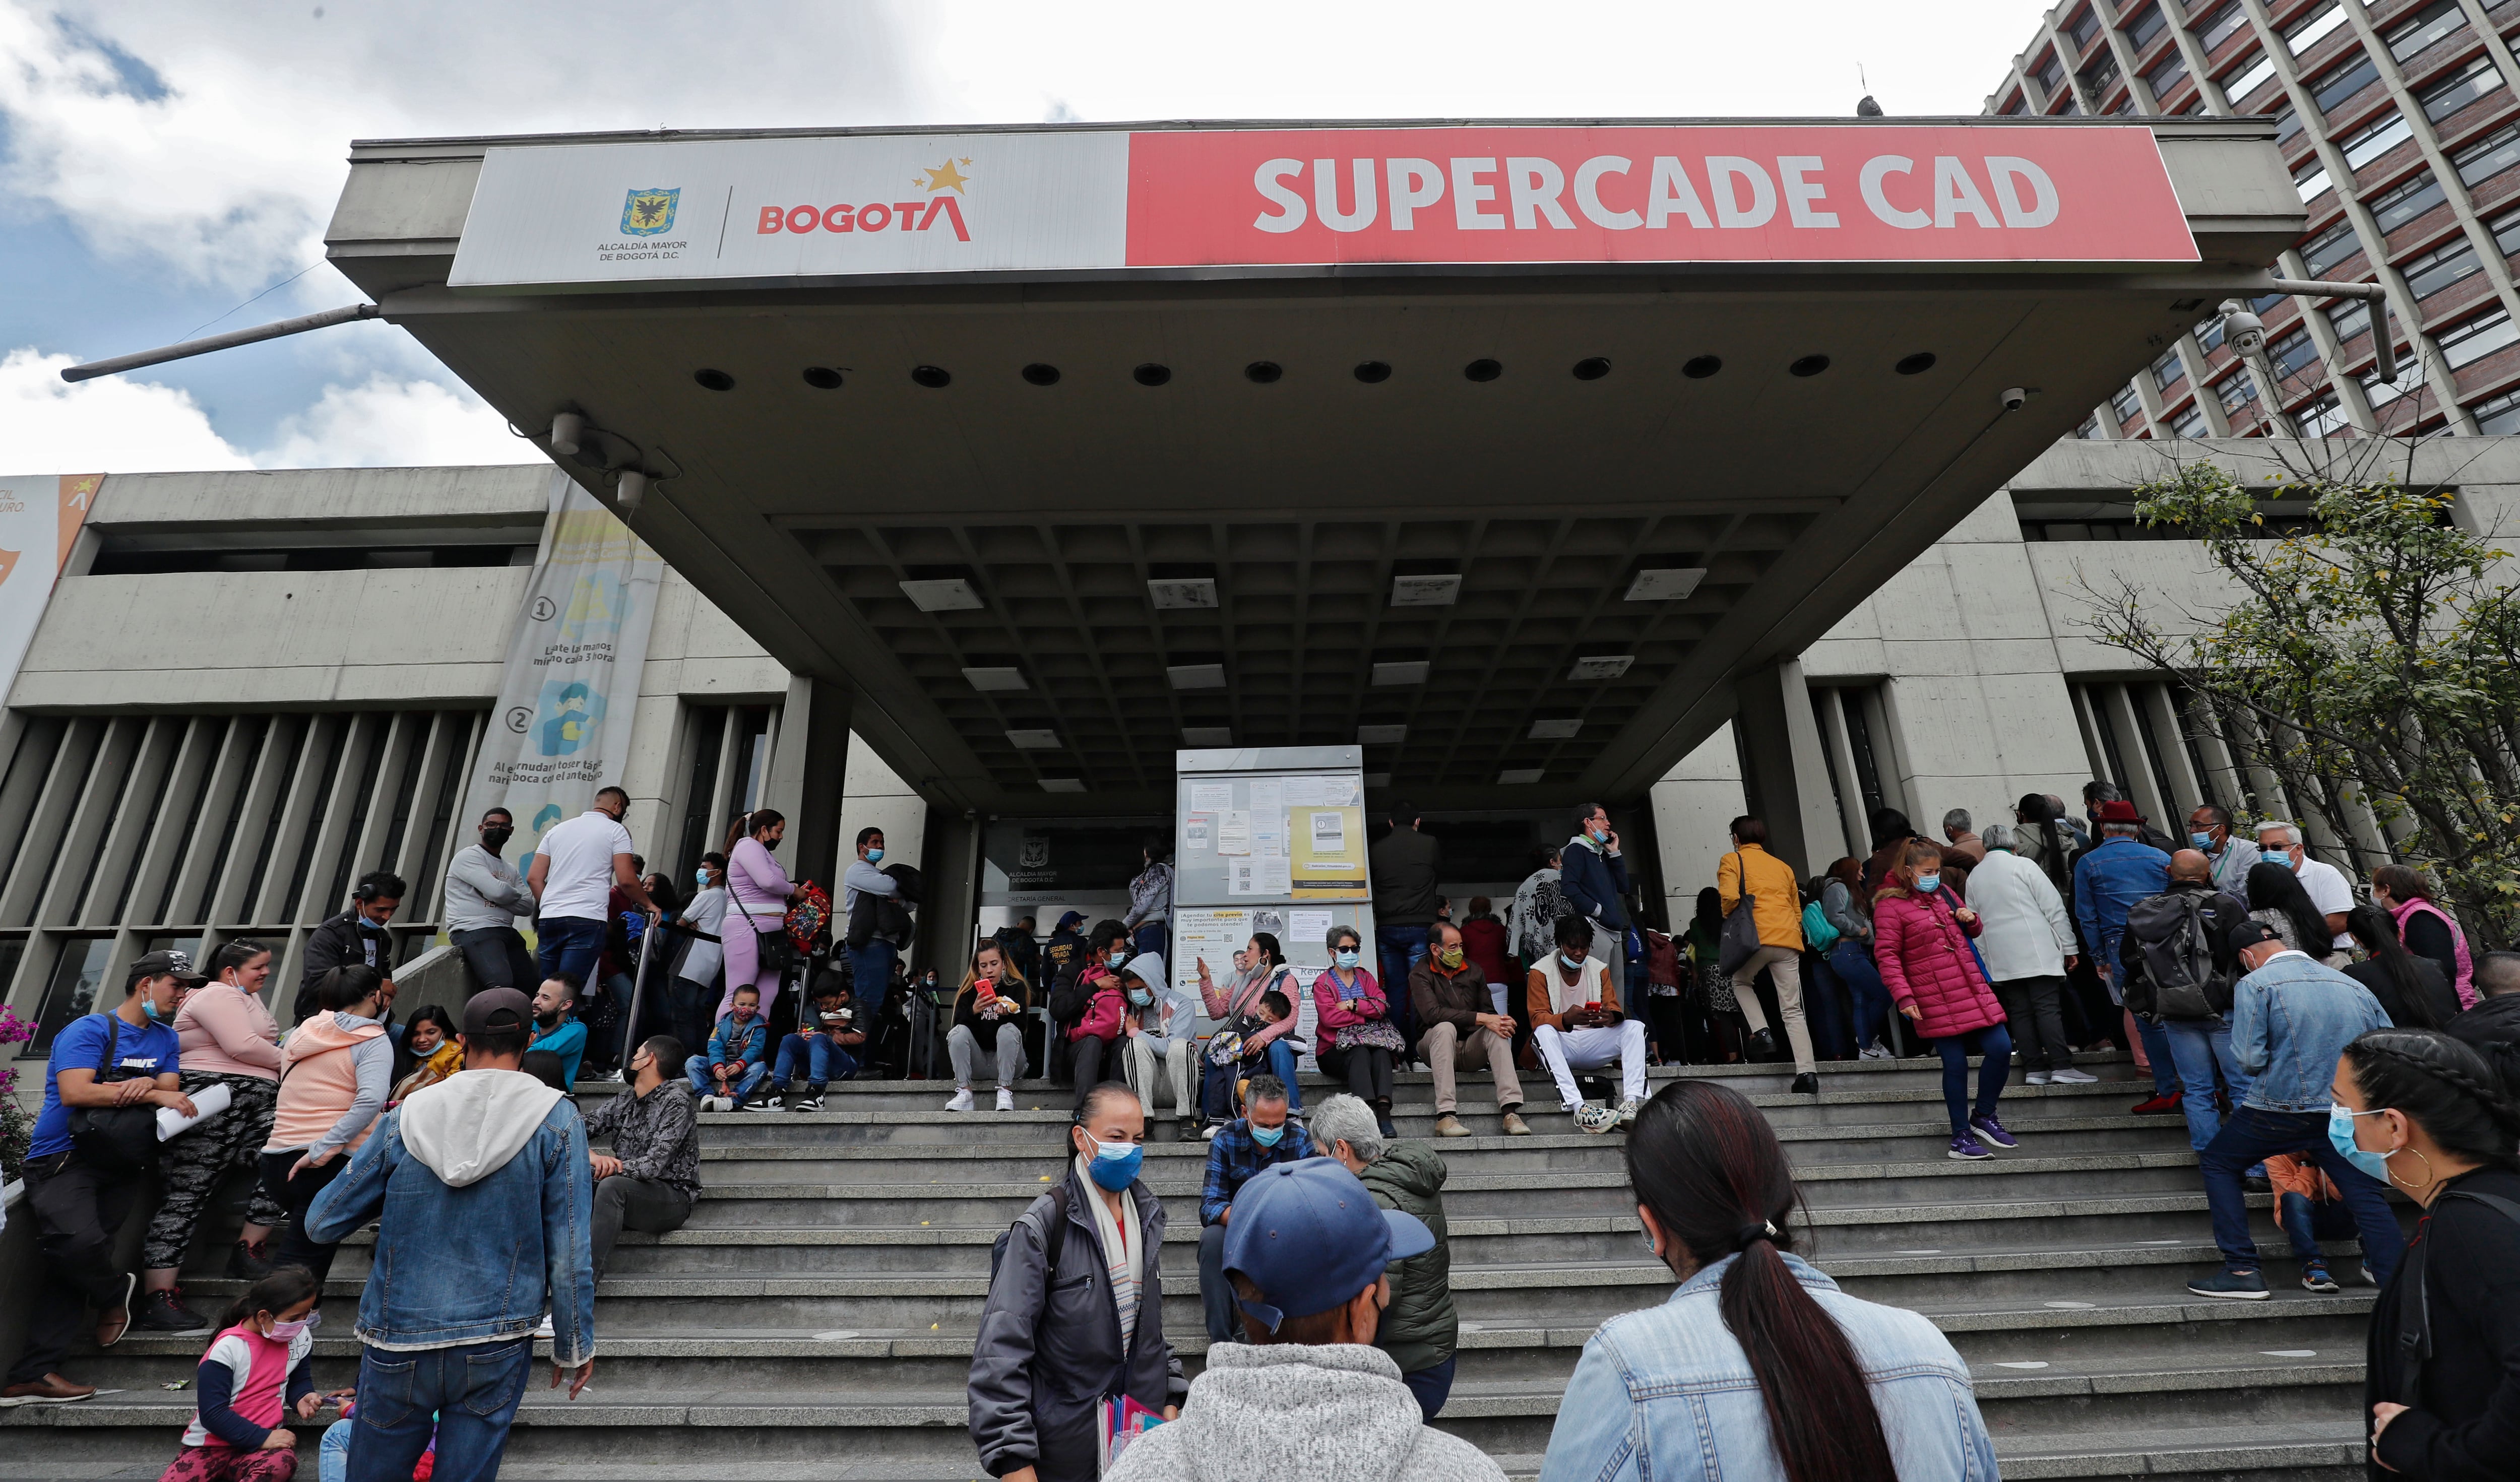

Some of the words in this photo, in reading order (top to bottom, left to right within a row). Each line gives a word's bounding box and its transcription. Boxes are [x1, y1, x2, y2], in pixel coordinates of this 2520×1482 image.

[1252, 155, 1841, 234] SUPERCADE
[1859, 154, 2062, 230] CAD
[597, 241, 648, 250] ALCALDÍA
[616, 251, 658, 260] BOGOTÁ
[536, 602, 545, 616] 1
[583, 643, 611, 651] manos
[586, 653, 590, 661] 3
[515, 712, 526, 728] 2
[493, 762, 505, 772] Al
[558, 760, 581, 769] toser
[488, 774, 510, 785] nari
[512, 772, 539, 783] boca
[556, 771, 564, 781] el
[1049, 944, 1073, 953] SEGURIDAD
[1052, 950, 1070, 959] PRIVADA
[120, 1058, 157, 1068] NIKE
